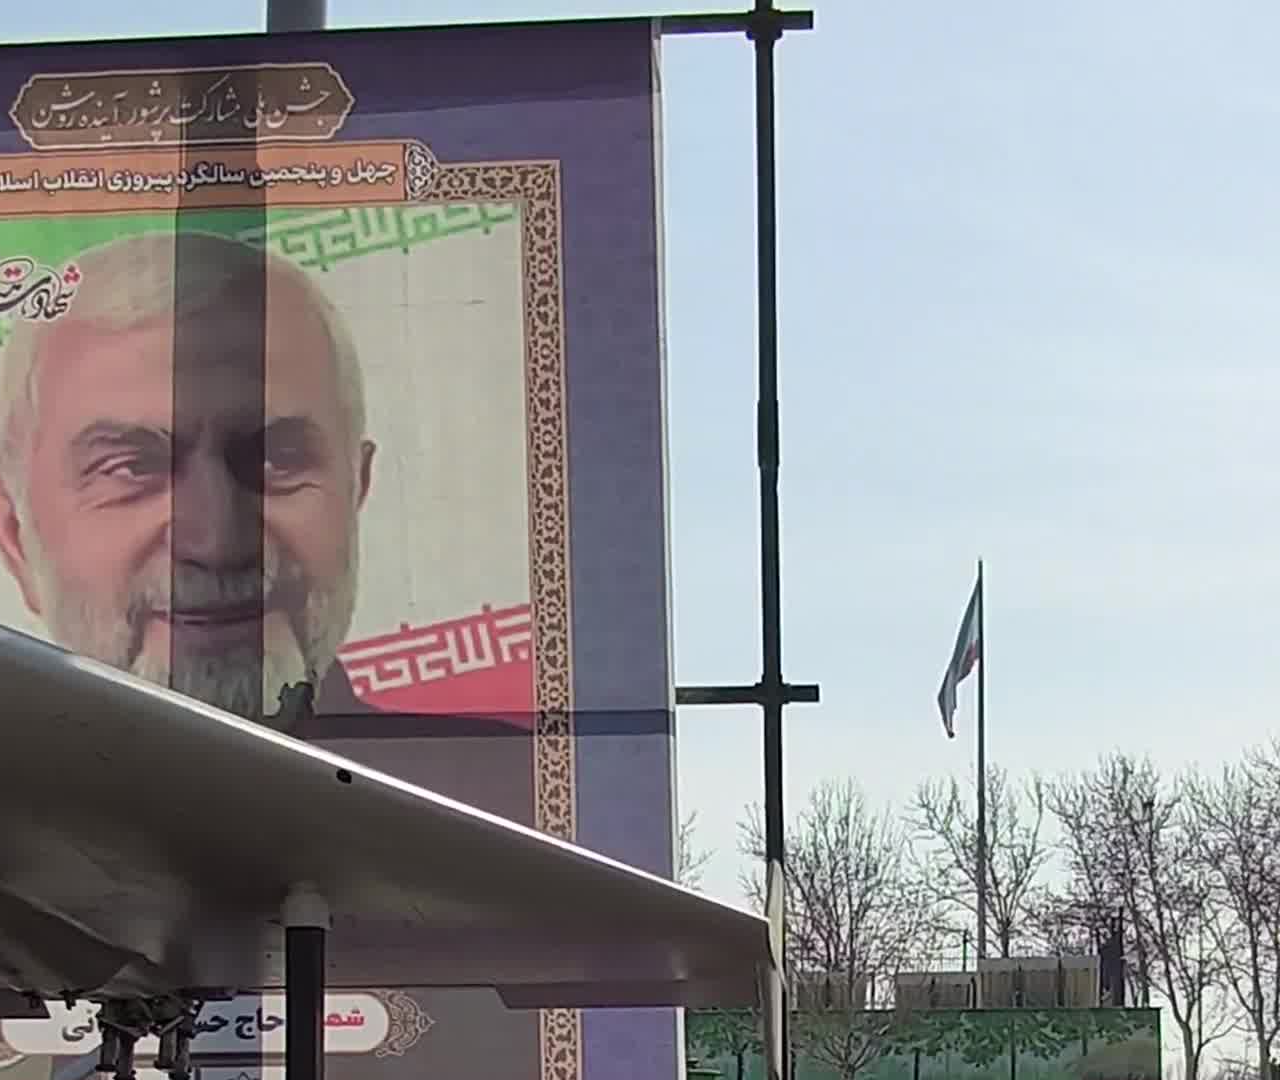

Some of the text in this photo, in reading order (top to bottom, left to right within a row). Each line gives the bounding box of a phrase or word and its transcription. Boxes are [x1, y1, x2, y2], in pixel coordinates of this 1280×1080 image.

[31, 73, 332, 143] جشن ملی مشارکت پرشور آینده روشن
[42, 168, 105, 196] انقلاب
[107, 171, 174, 197] پیروزی
[177, 162, 245, 193] سالگرد
[250, 162, 327, 190] پنجمین
[331, 167, 343, 186] و
[346, 159, 399, 184] چهل
[234, 1007, 286, 1041] حاج
